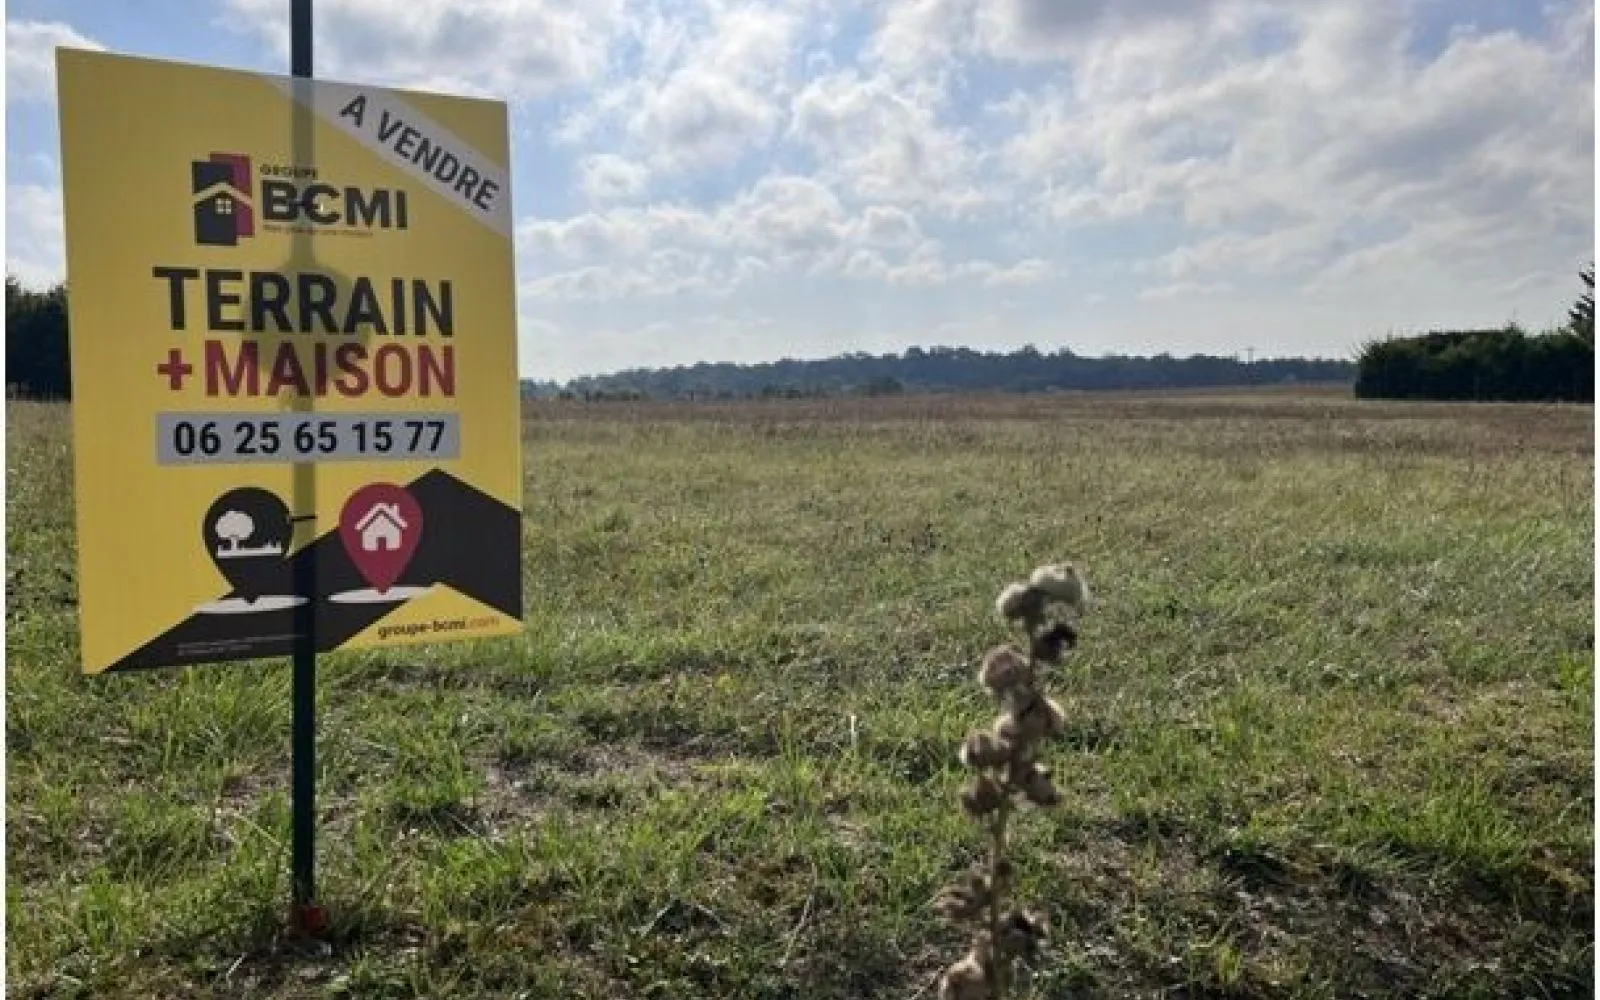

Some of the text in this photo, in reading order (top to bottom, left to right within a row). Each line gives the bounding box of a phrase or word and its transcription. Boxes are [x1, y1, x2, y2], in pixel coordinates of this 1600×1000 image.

[340, 95, 500, 211] A VENDRE
[262, 180, 408, 229] BCMI
[152, 266, 454, 337] TERRAIN
[173, 421, 445, 457] 06 25 65 15 77
[378, 616, 500, 640] groupe-bcmi.com
